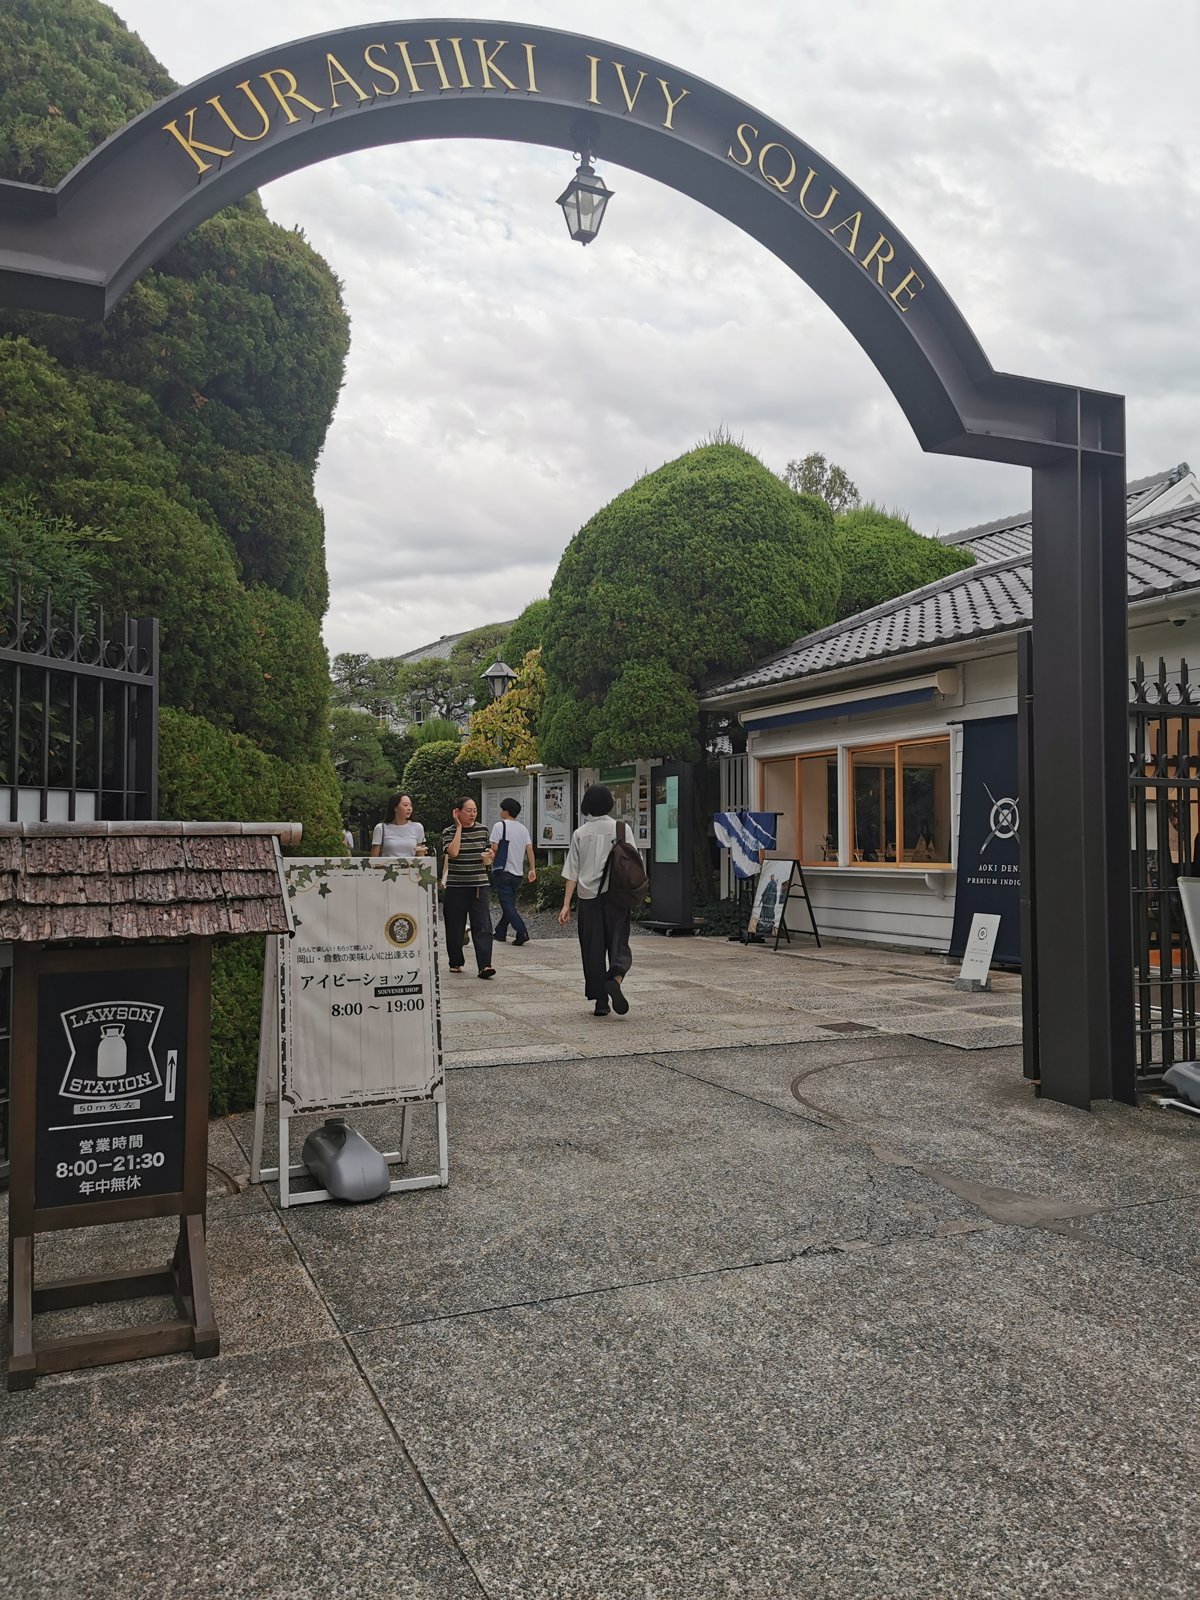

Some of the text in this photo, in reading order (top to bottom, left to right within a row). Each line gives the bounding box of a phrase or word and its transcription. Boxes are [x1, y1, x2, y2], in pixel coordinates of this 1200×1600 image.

[162, 38, 926, 313] KURASHIKI IVY SQUARE
[978, 864, 1021, 873] AOKI DEN
[967, 877, 998, 885] PREMIUM
[300, 967, 421, 991] アイビーショップ
[69, 1007, 155, 1028] LAWSON
[331, 1002, 363, 1017] 8:00
[386, 998, 425, 1013] 19:00
[69, 1072, 152, 1094] STATION
[79, 1134, 143, 1155] 営業時間
[79, 1174, 142, 1196] 年中無休
